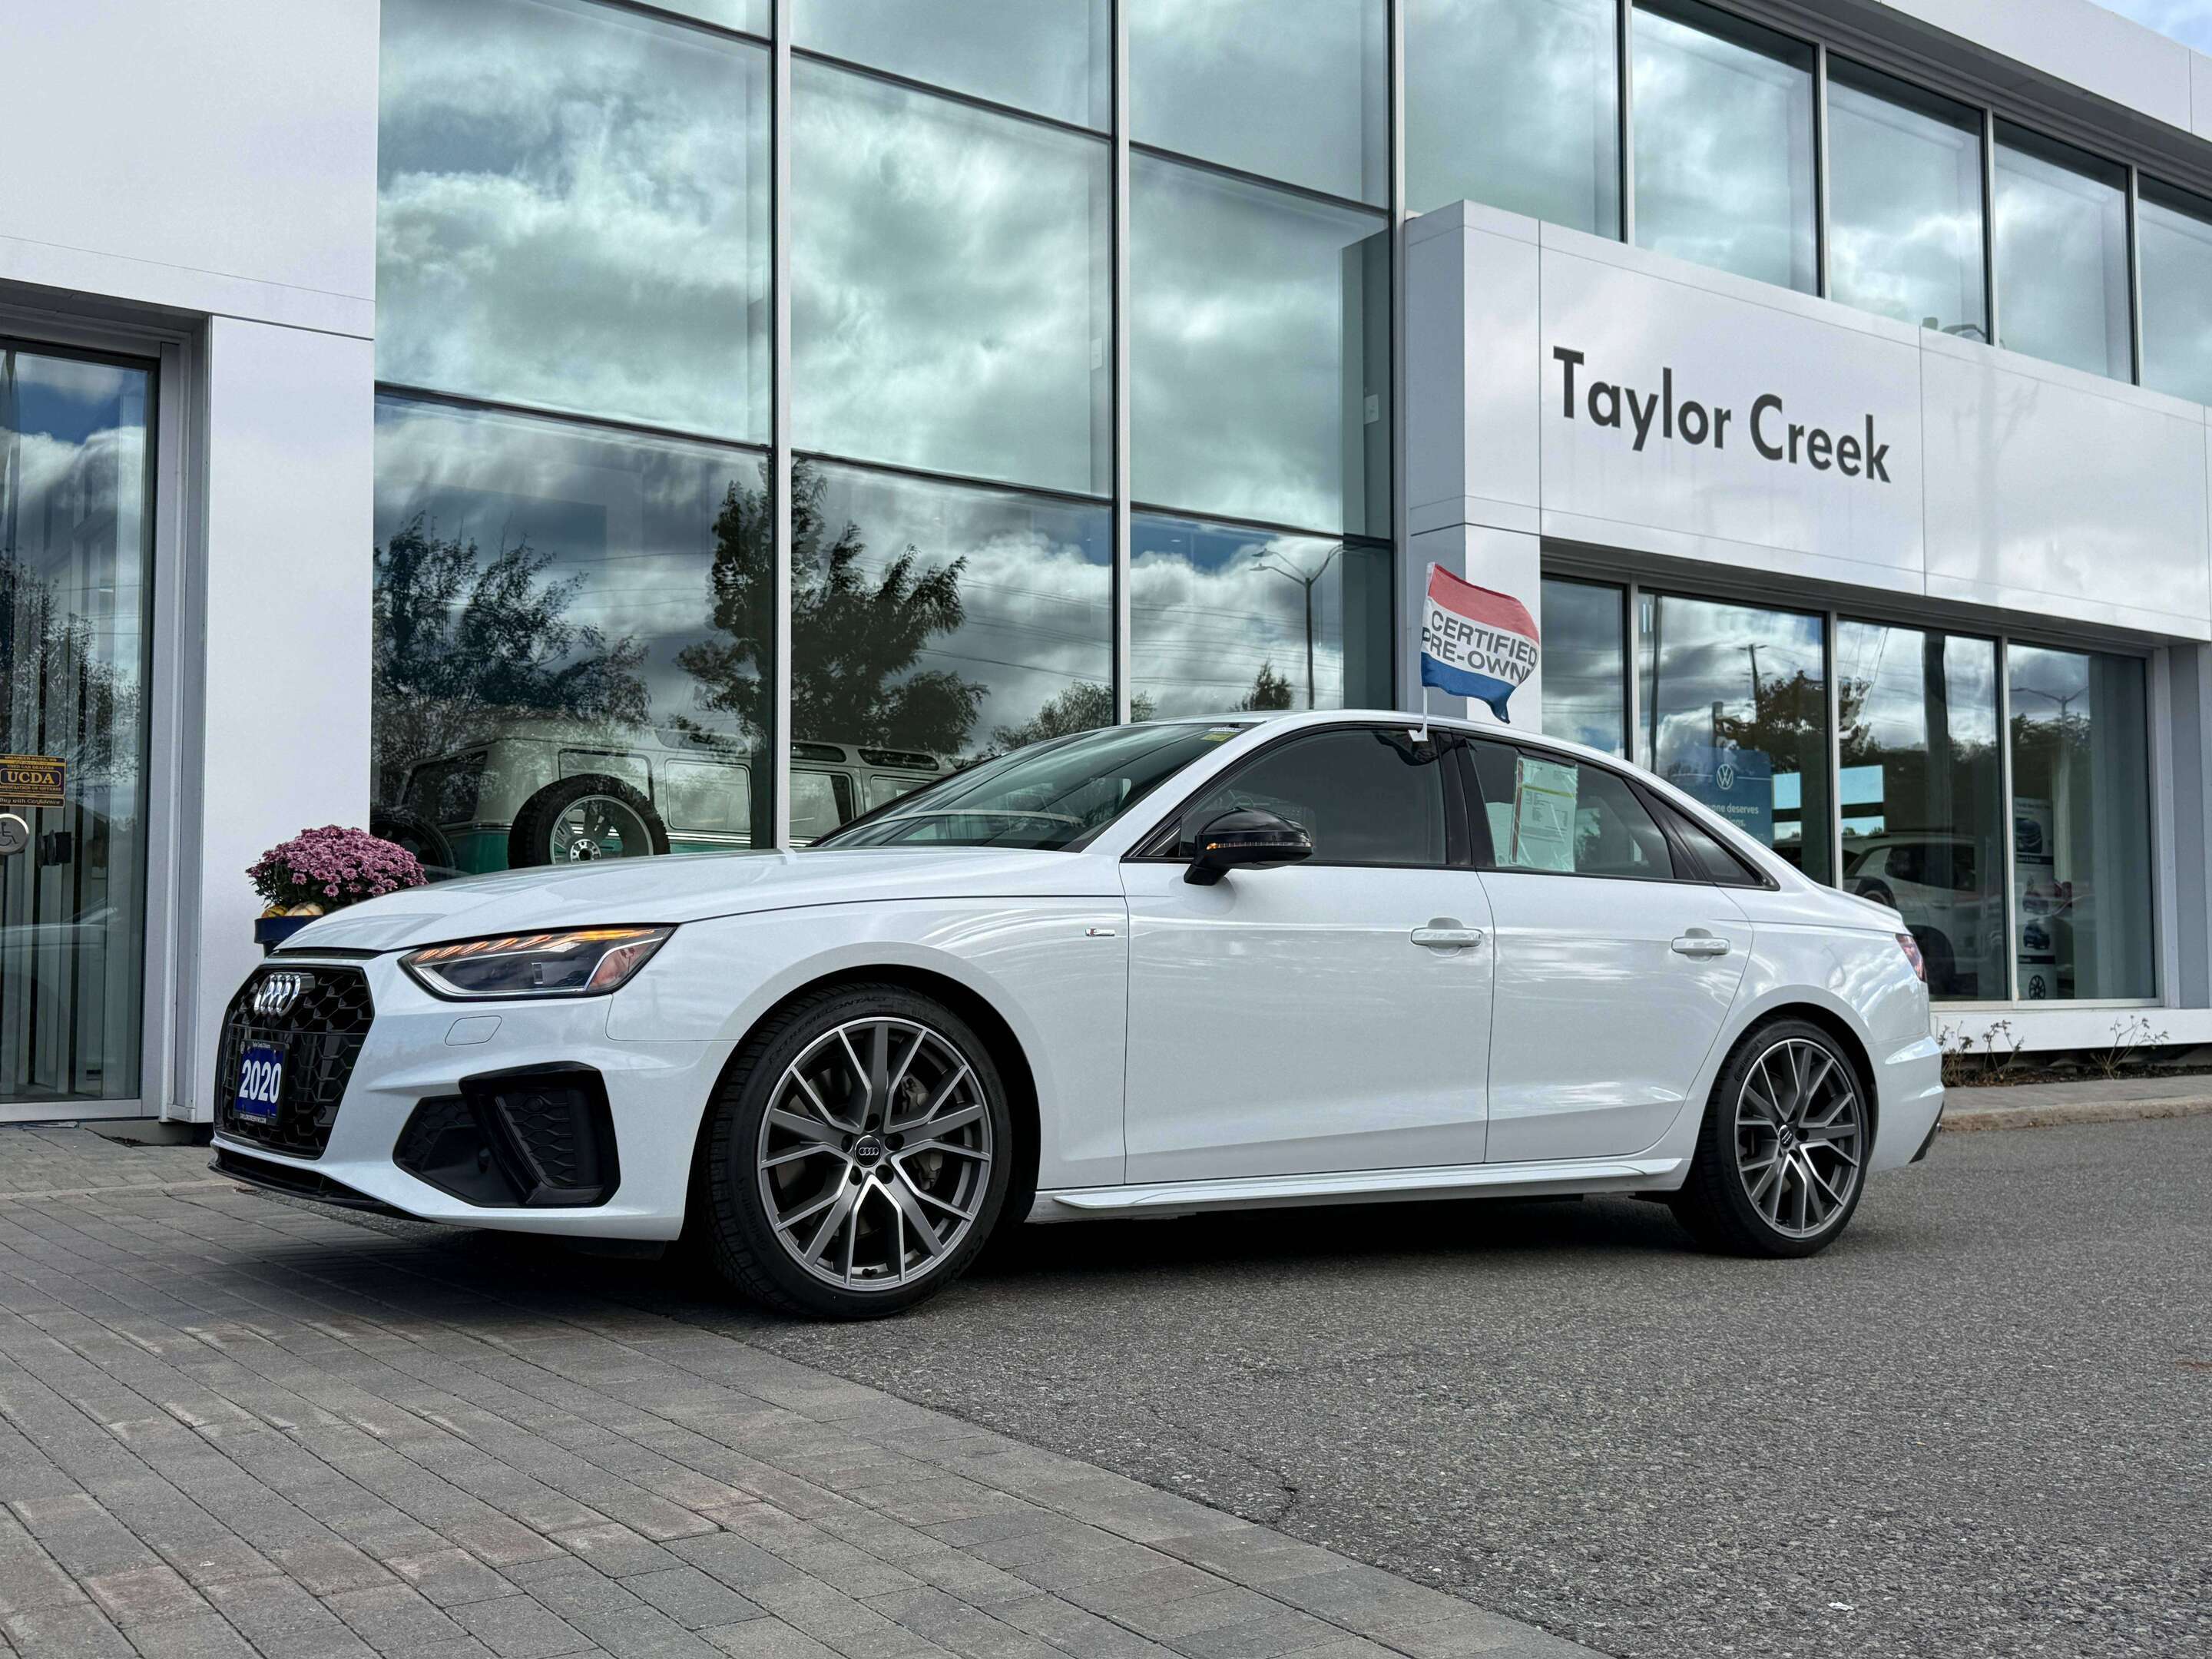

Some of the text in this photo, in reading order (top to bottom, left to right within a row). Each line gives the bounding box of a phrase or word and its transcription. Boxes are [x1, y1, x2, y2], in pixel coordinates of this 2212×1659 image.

[1553, 345, 1891, 484] Taylor Creek
[1431, 610, 1538, 667] CERTIFIED
[7, 771, 55, 784] UCDA
[1727, 802, 1760, 815] deserves
[239, 1059, 282, 1104] 2020
